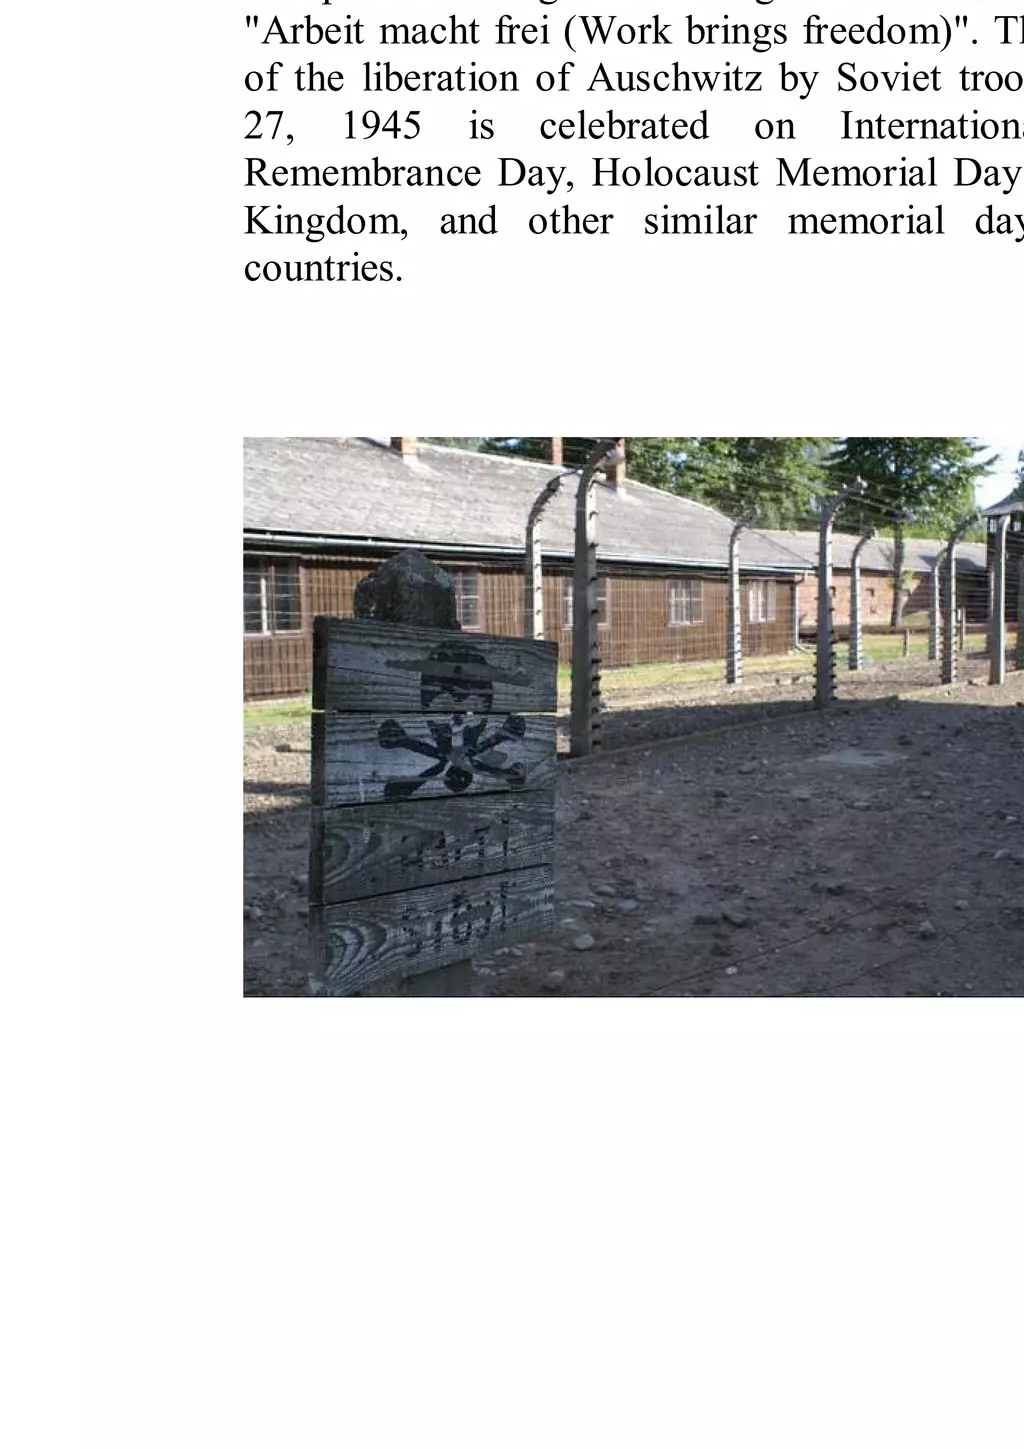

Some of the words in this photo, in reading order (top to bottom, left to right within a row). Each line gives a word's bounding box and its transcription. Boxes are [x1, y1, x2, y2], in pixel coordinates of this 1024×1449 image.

[245, 14, 365, 45] "Arbeit
[379, 14, 481, 45] macht
[494, 14, 550, 45] frei
[564, 14, 673, 53] (Work
[685, 14, 788, 53] brings
[802, 14, 978, 53] freedom)".
[244, 61, 284, 92] of
[294, 61, 344, 92] the
[362, 61, 520, 92] liberation
[535, 61, 576, 92] of
[586, 61, 763, 92] Auschwitz
[778, 61, 820, 101] by
[837, 61, 942, 92] Soviet
[244, 109, 294, 146] 27,
[345, 109, 421, 140] 1945
[469, 109, 495, 140] is
[540, 109, 710, 140] celebrated
[754, 118, 796, 140] on
[243, 156, 481, 187] Remembrance
[497, 157, 574, 195] Day,
[591, 156, 760, 187] Holocaust
[775, 156, 938, 187] Memorial
[953, 157, 1023, 195] Day
[244, 251, 402, 282] countries.
